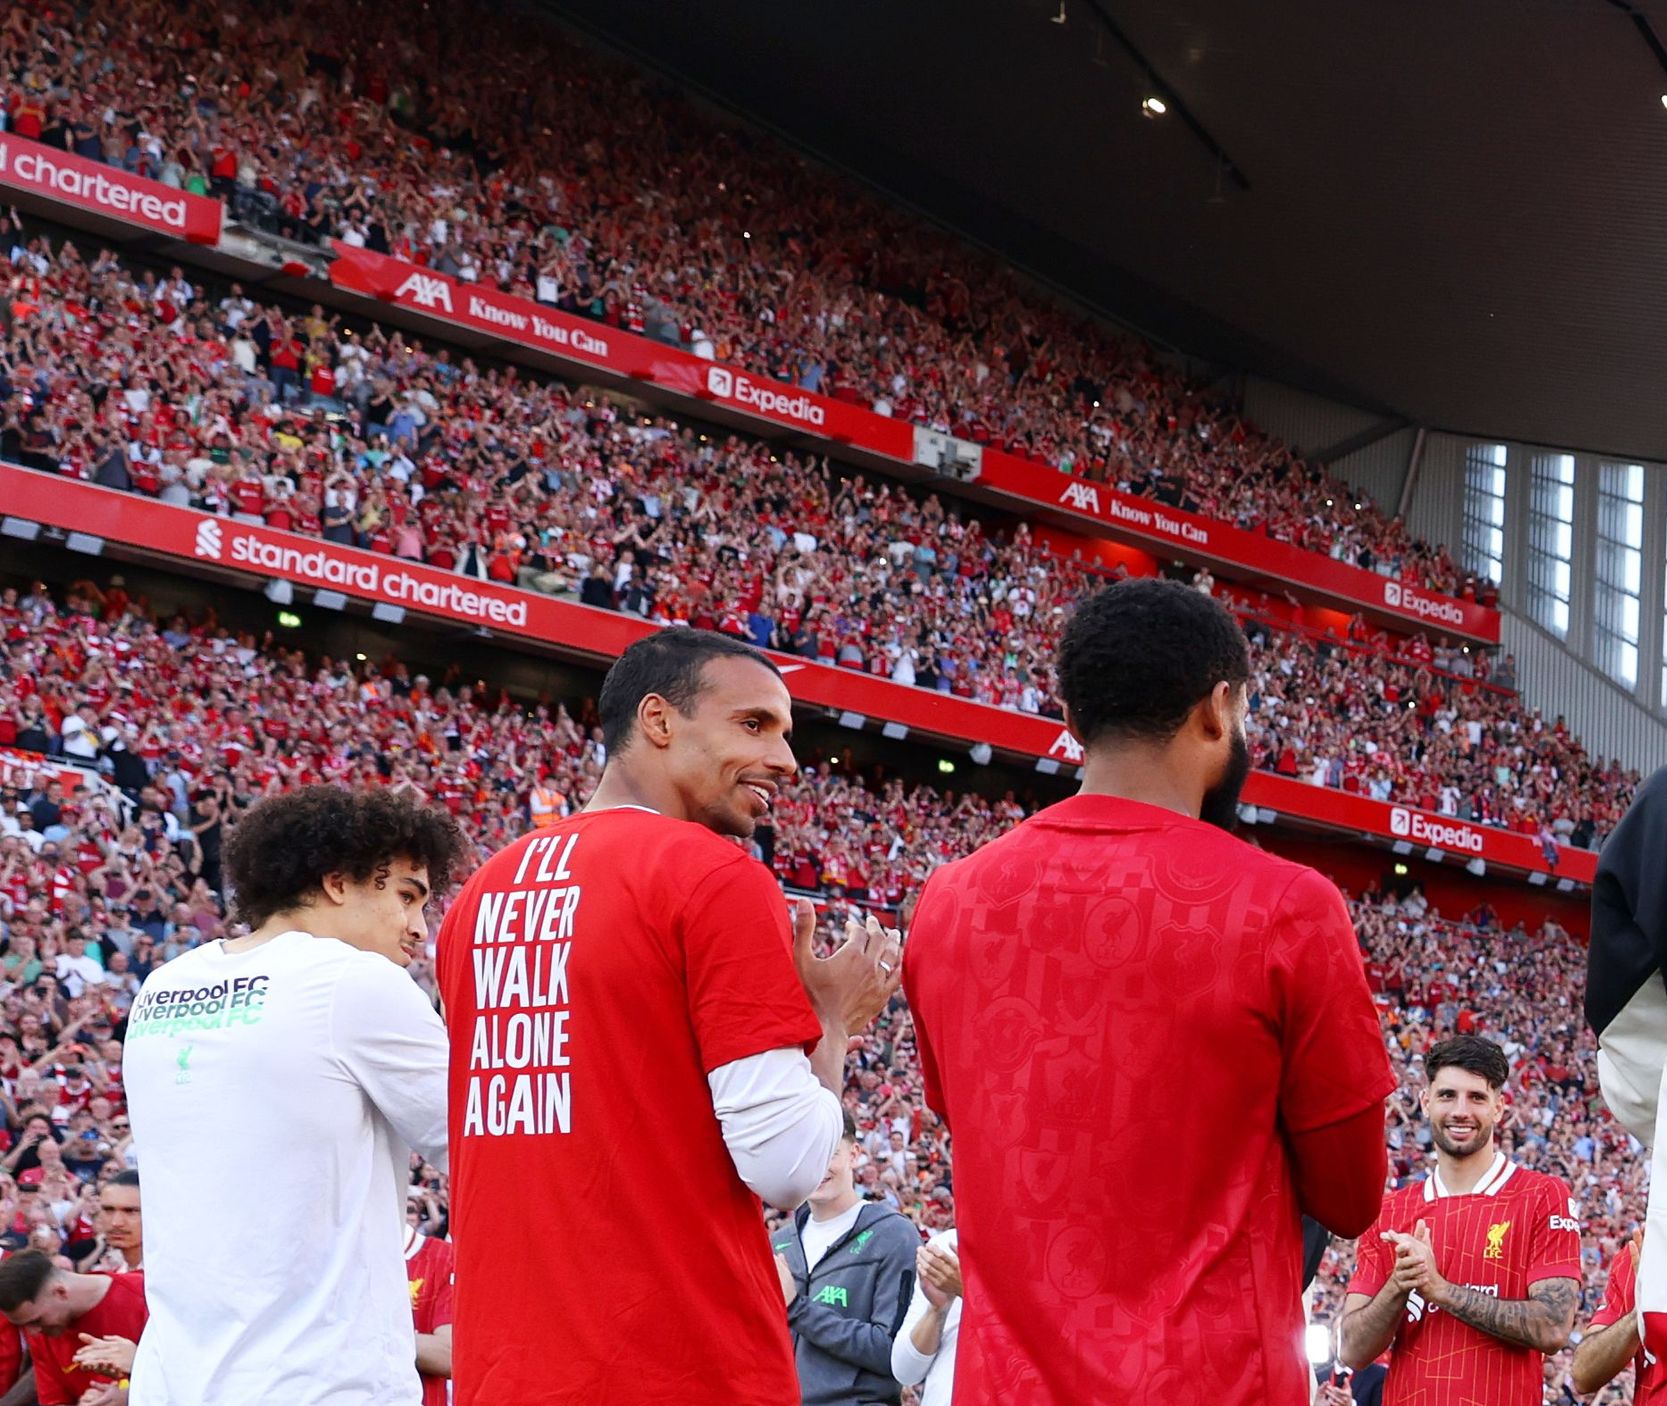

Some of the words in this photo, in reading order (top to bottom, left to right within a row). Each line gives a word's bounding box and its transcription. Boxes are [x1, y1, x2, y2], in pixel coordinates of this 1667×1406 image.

[14, 153, 187, 227] chartered
[394, 271, 454, 313] AXA
[468, 296, 529, 331] Know
[531, 316, 570, 346] You
[571, 330, 608, 358] Can
[734, 378, 825, 426] Expedia
[1058, 482, 1100, 514] AXA
[1110, 499, 1151, 527] Know
[1154, 512, 1180, 535] You
[1181, 521, 1208, 544] Can
[231, 535, 378, 592] standard
[382, 572, 527, 626] chartered
[1403, 588, 1463, 624] Expedia
[513, 833, 579, 884] I'LL
[1412, 813, 1483, 852] Expedia
[474, 886, 580, 945] NEVER
[230, 989, 266, 1009] FC
[233, 975, 270, 993] FC
[472, 941, 572, 1010] WALK
[470, 1010, 571, 1071] ALONE
[464, 1072, 571, 1138] AGAIN
[812, 1285, 848, 1308] AXA
